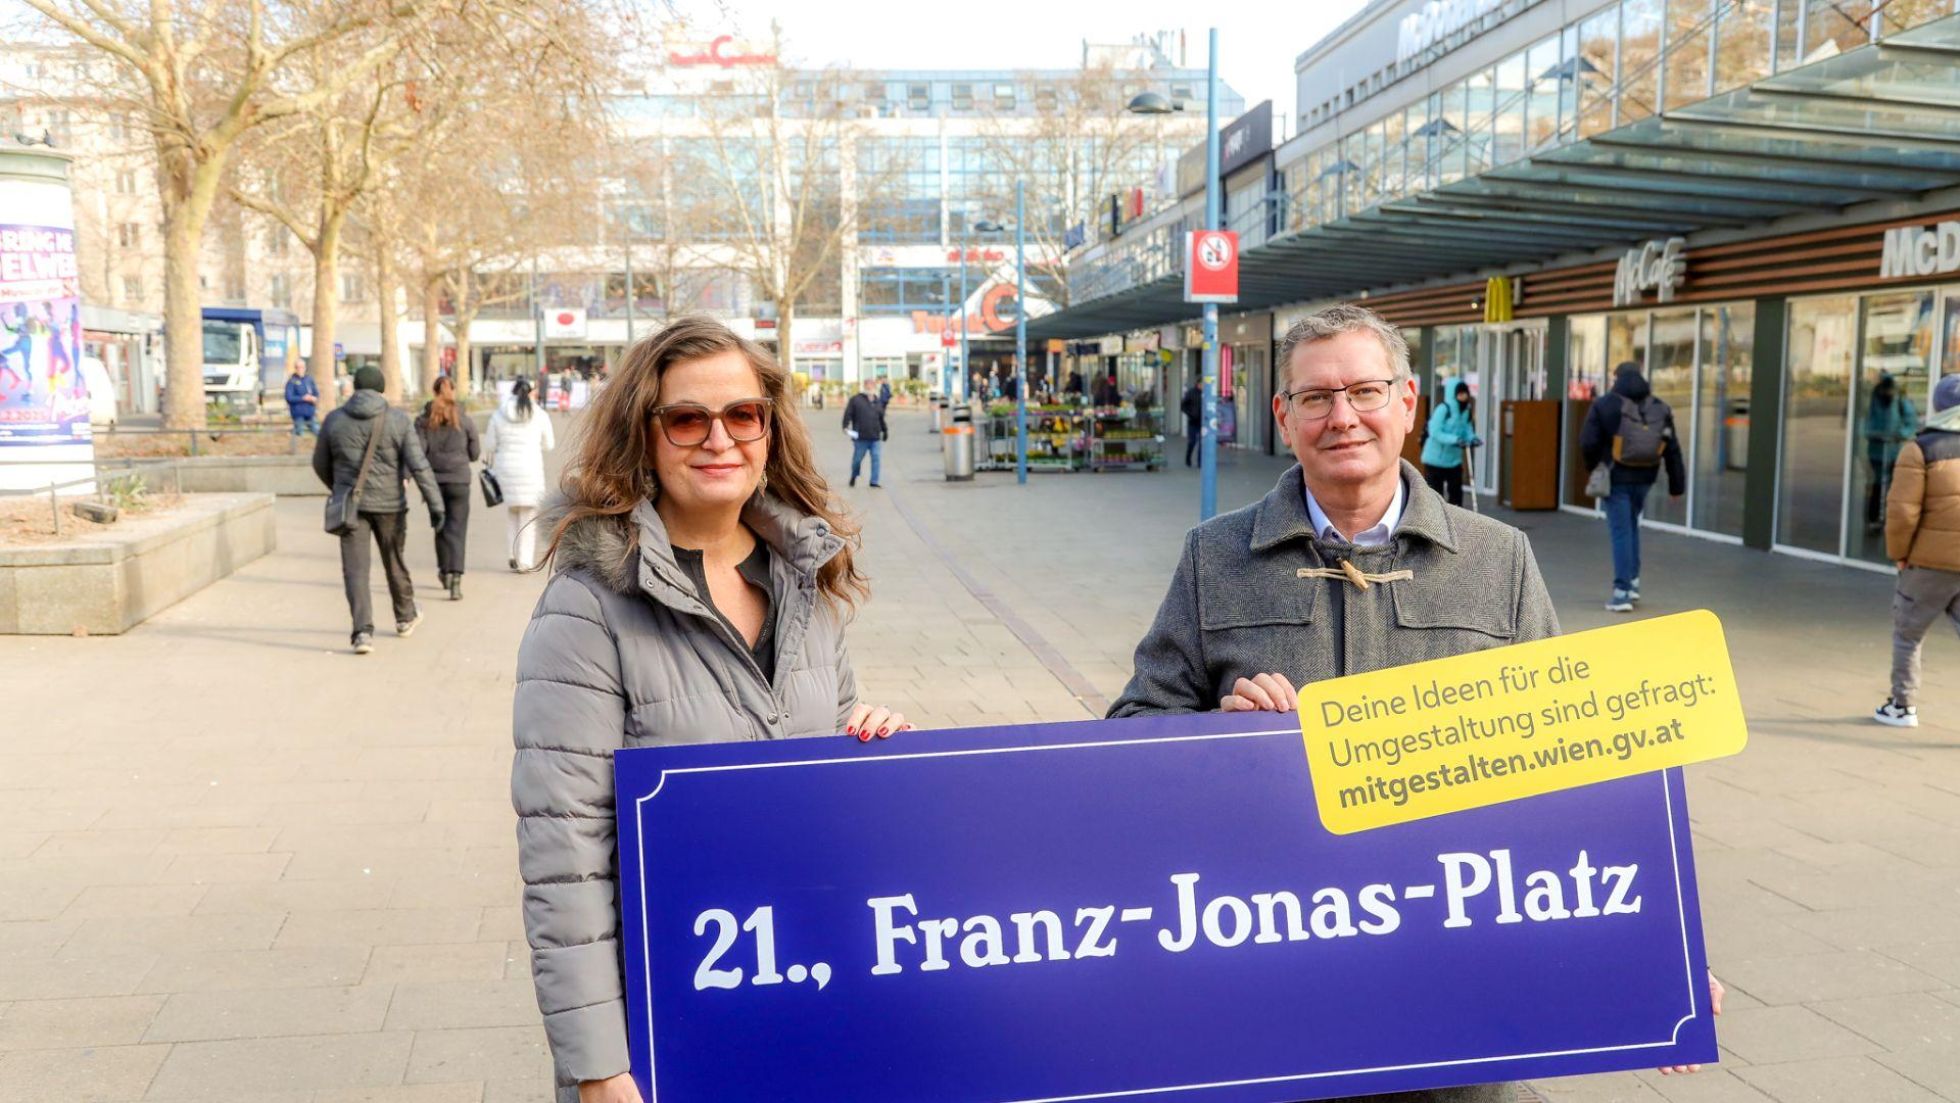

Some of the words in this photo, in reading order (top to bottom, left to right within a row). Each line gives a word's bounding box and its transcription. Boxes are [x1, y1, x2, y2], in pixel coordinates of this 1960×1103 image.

[1321, 697, 1406, 728] Deine
[1412, 680, 1493, 711] Ideen
[1498, 664, 1539, 693] für
[1548, 655, 1590, 684] die
[1329, 712, 1535, 767] Umgestaltung
[1541, 690, 1599, 726] sind
[1606, 673, 1717, 721] gefragt:
[1339, 718, 1685, 808] mitgestalten.wien.gv.at
[693, 905, 832, 991] 21.,
[866, 849, 1642, 976] Franz-Jonas-Platz
